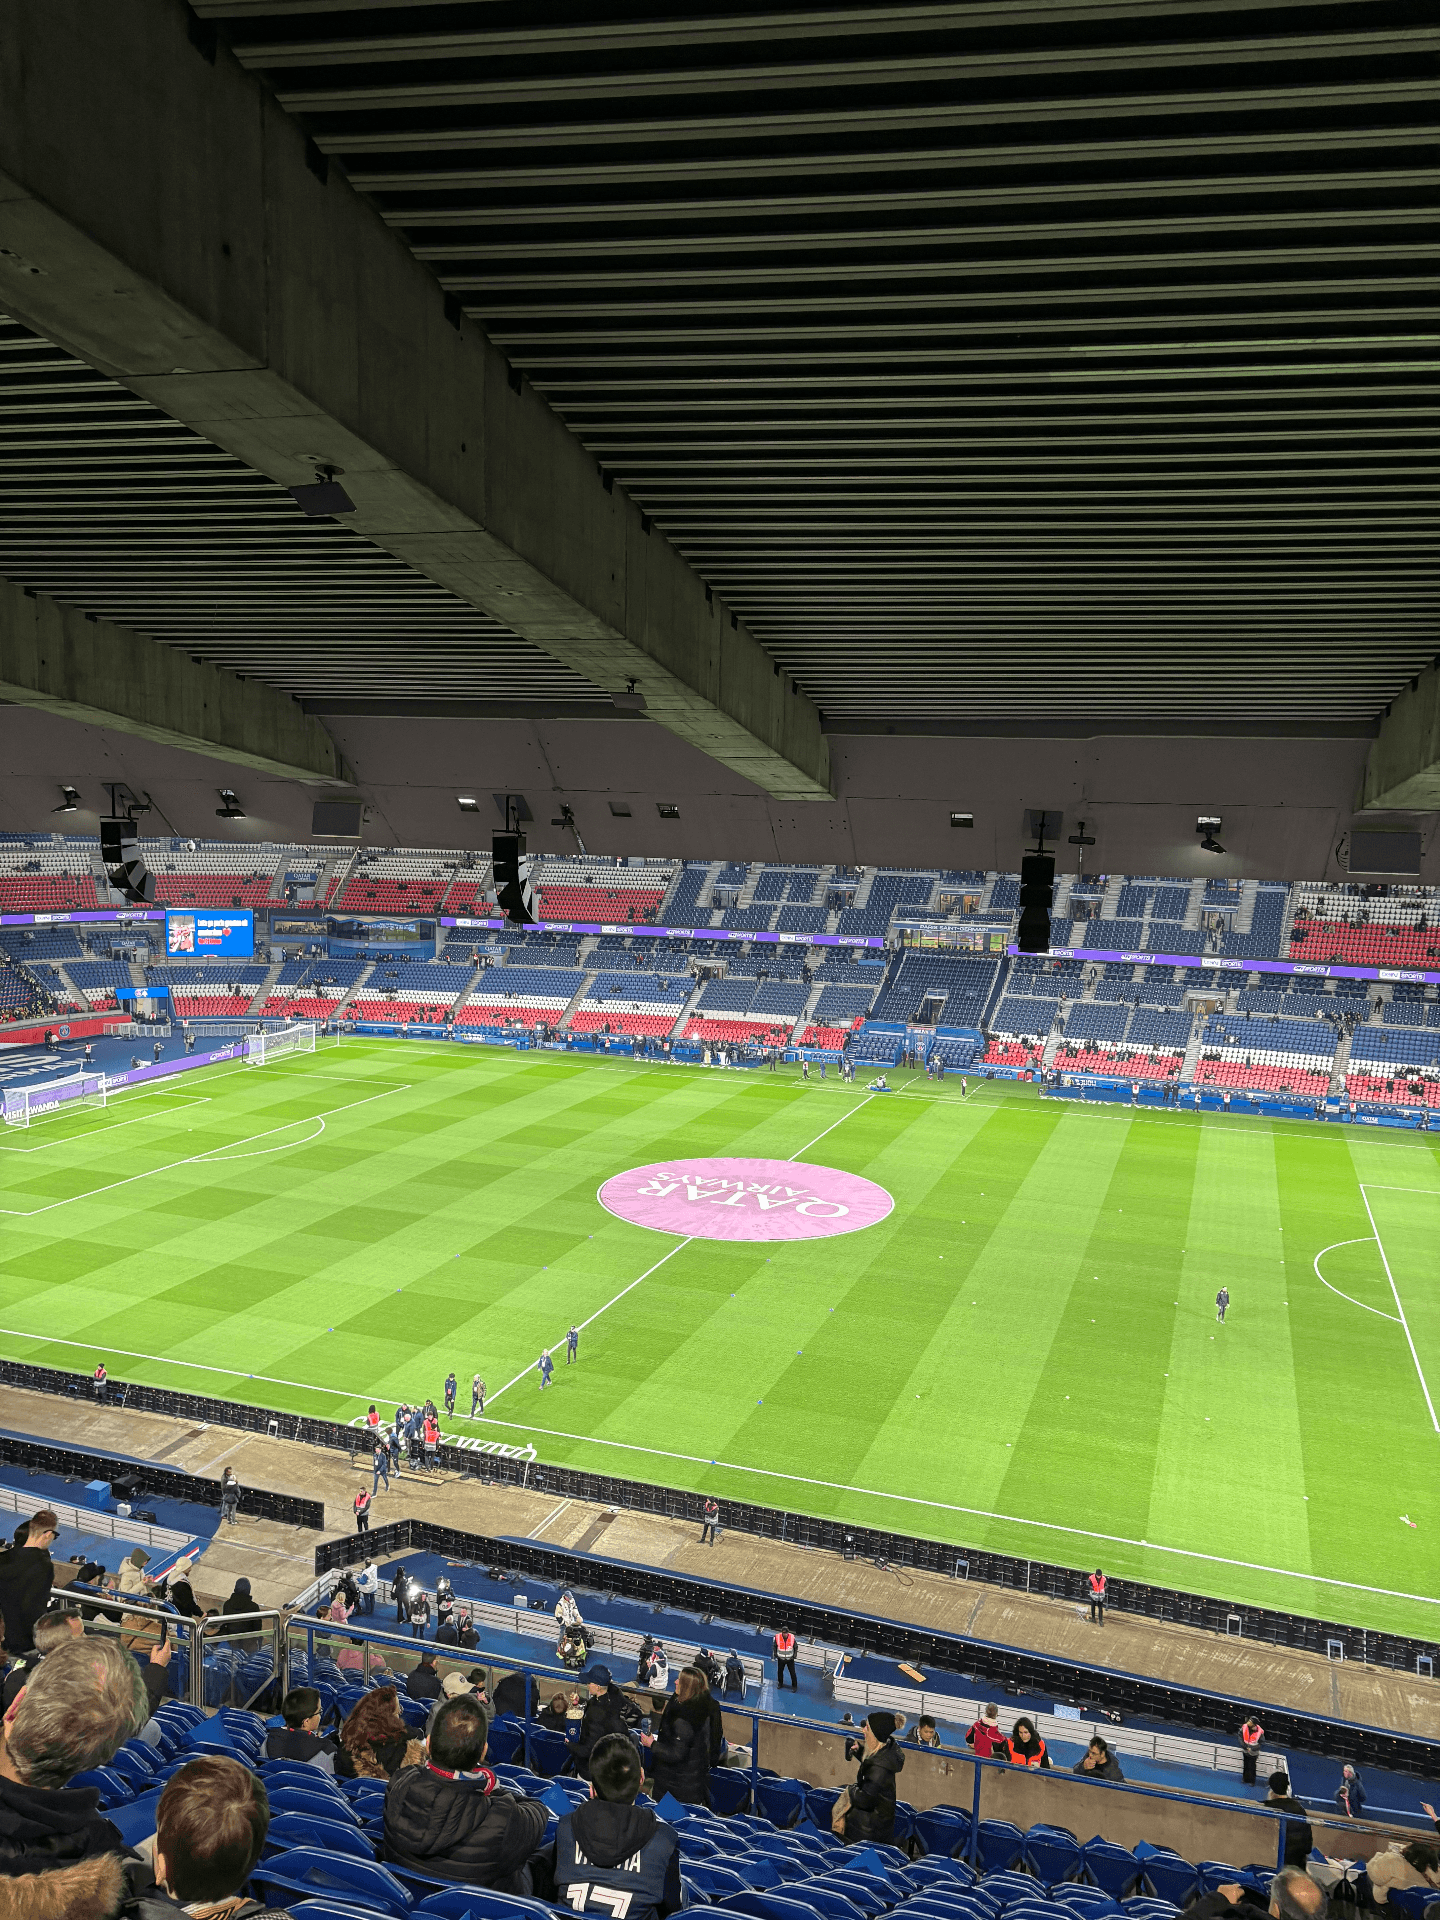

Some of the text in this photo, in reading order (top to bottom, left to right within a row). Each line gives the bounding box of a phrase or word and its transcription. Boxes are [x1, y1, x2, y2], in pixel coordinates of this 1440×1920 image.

[637, 1179, 850, 1218] QATAR
[653, 1172, 811, 1197] AIRWAYS
[567, 1882, 633, 1919] 17
